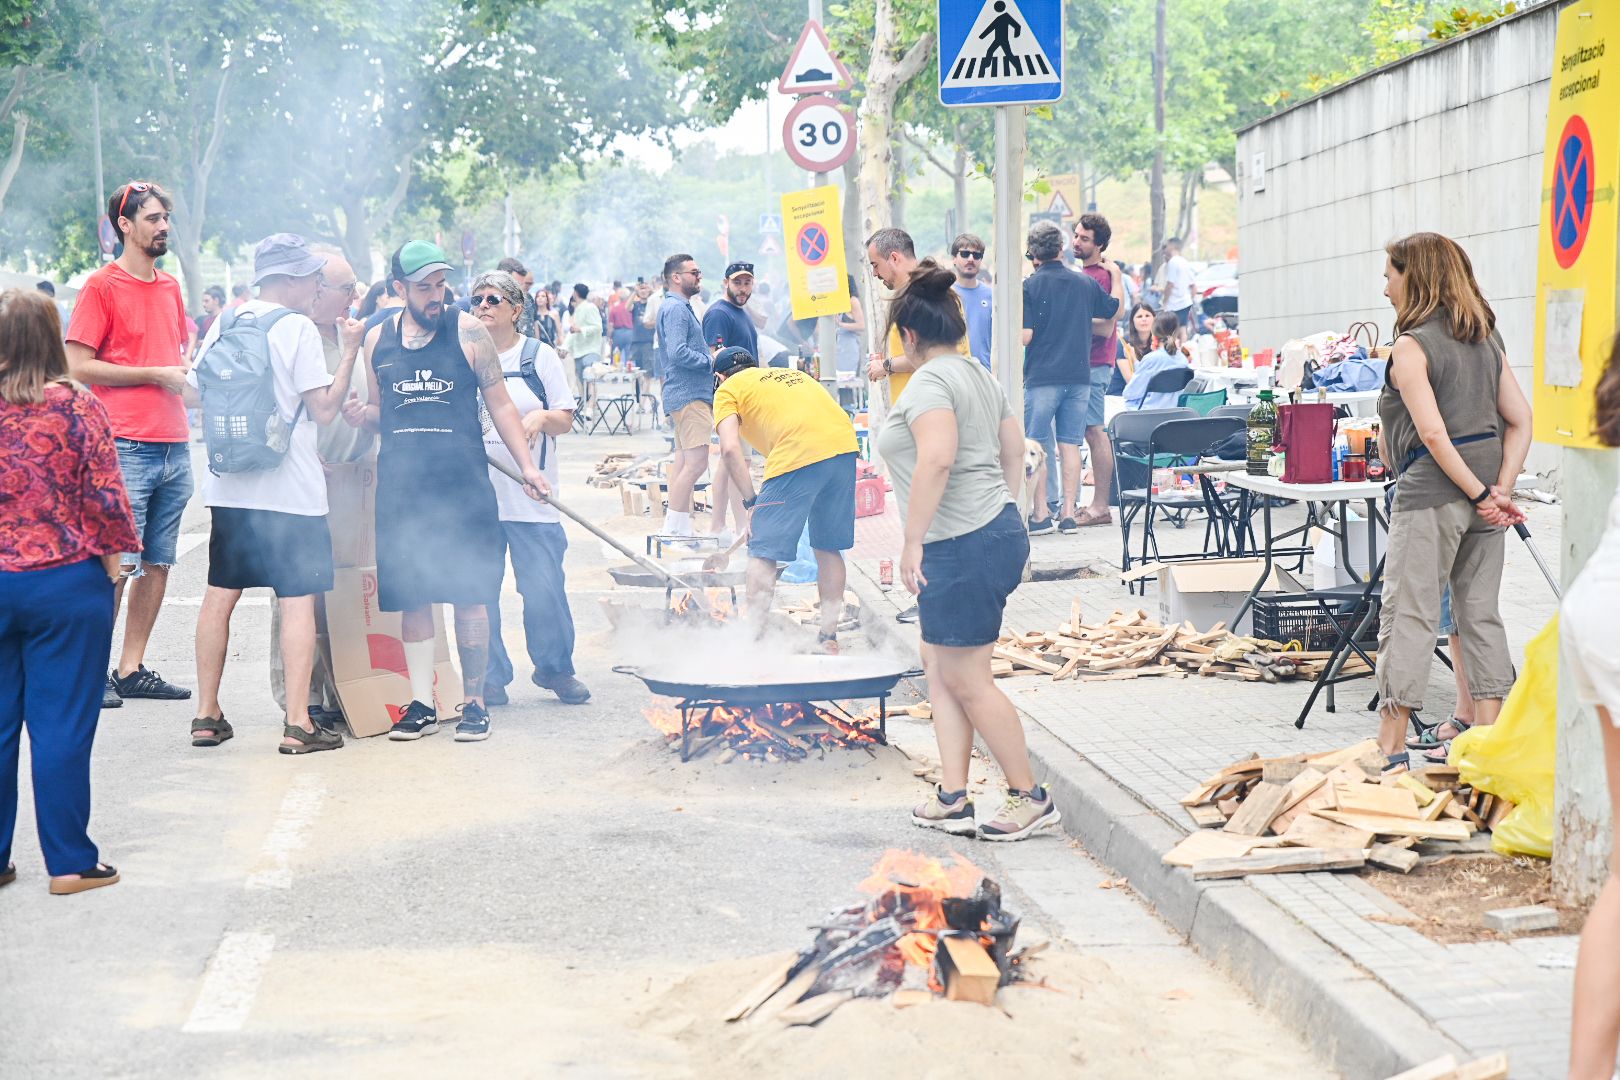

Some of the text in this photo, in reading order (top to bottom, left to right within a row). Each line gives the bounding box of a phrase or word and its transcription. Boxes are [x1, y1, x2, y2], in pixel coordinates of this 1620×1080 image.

[1559, 68, 1600, 101] excepcional
[799, 121, 842, 147] 30
[415, 370, 420, 381] I
[425, 381, 443, 391] PAELLA
